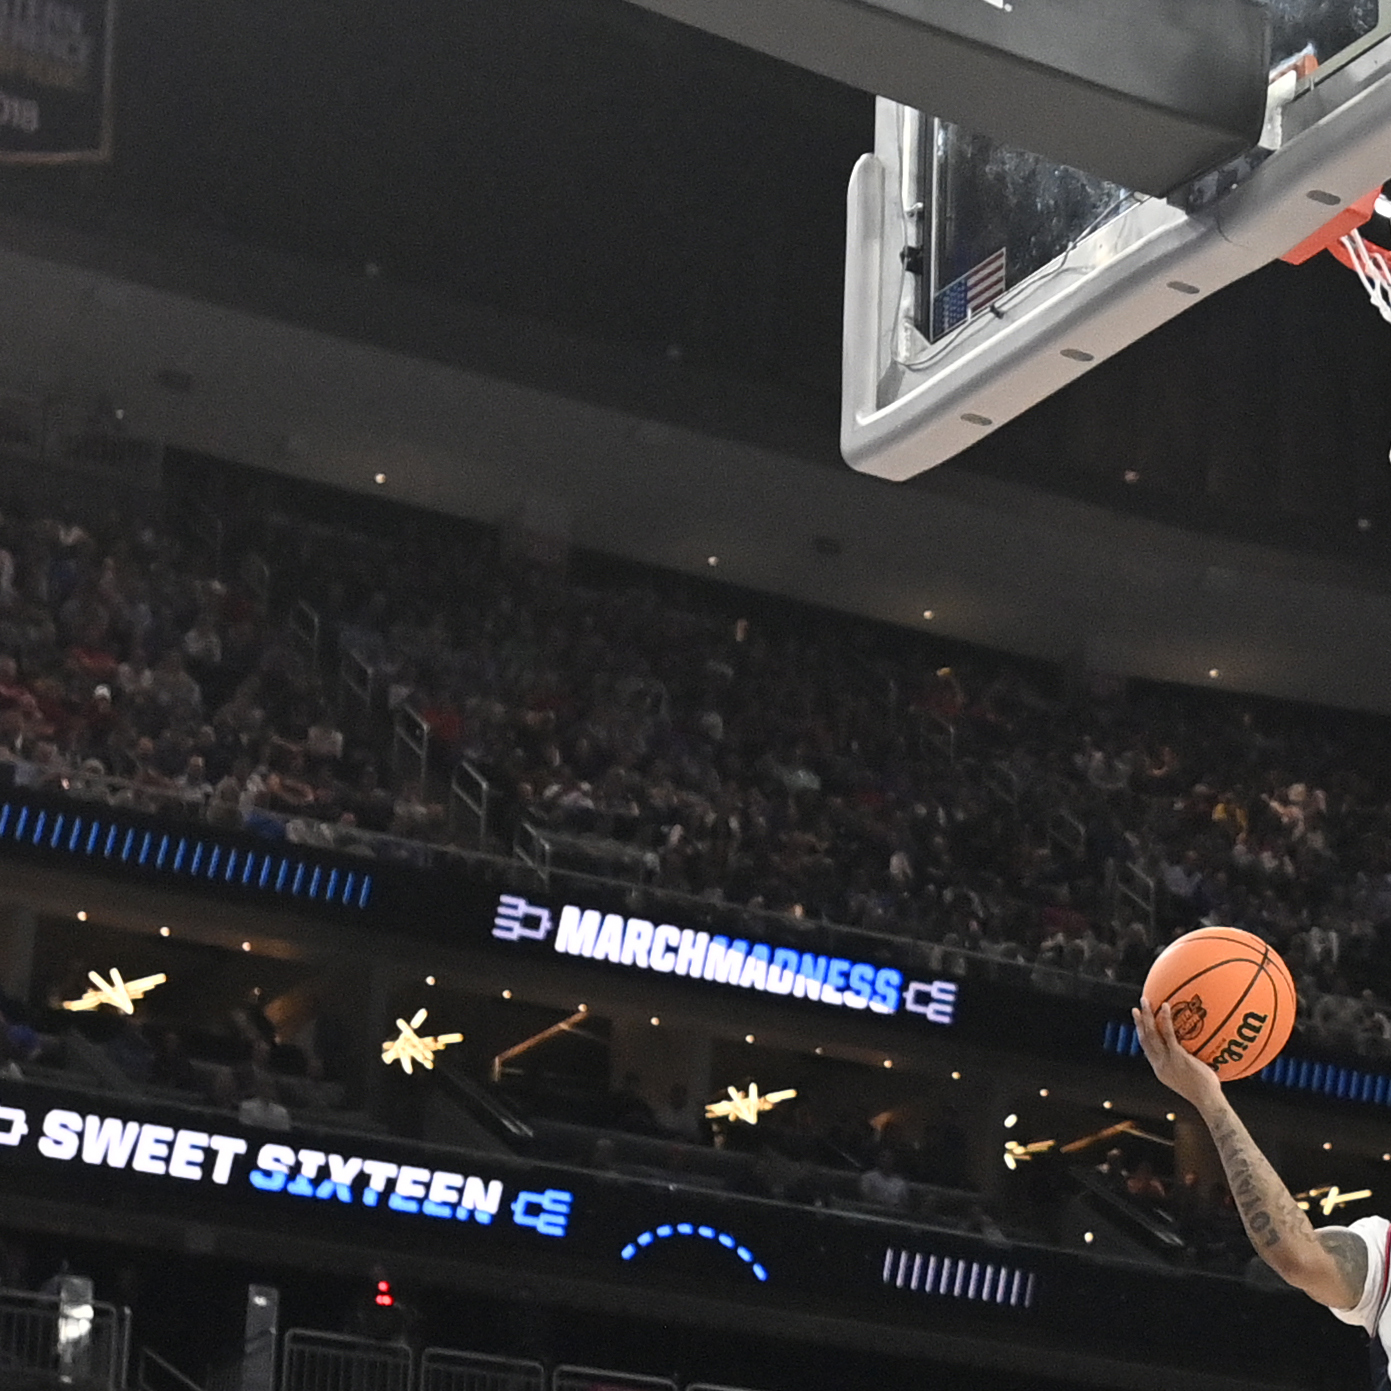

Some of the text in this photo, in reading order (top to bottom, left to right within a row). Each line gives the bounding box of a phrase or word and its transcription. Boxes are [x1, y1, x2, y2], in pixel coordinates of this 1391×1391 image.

[1210, 1011, 1268, 1072] Wils
[38, 1109, 503, 1214] SWEET SIXTEEN
